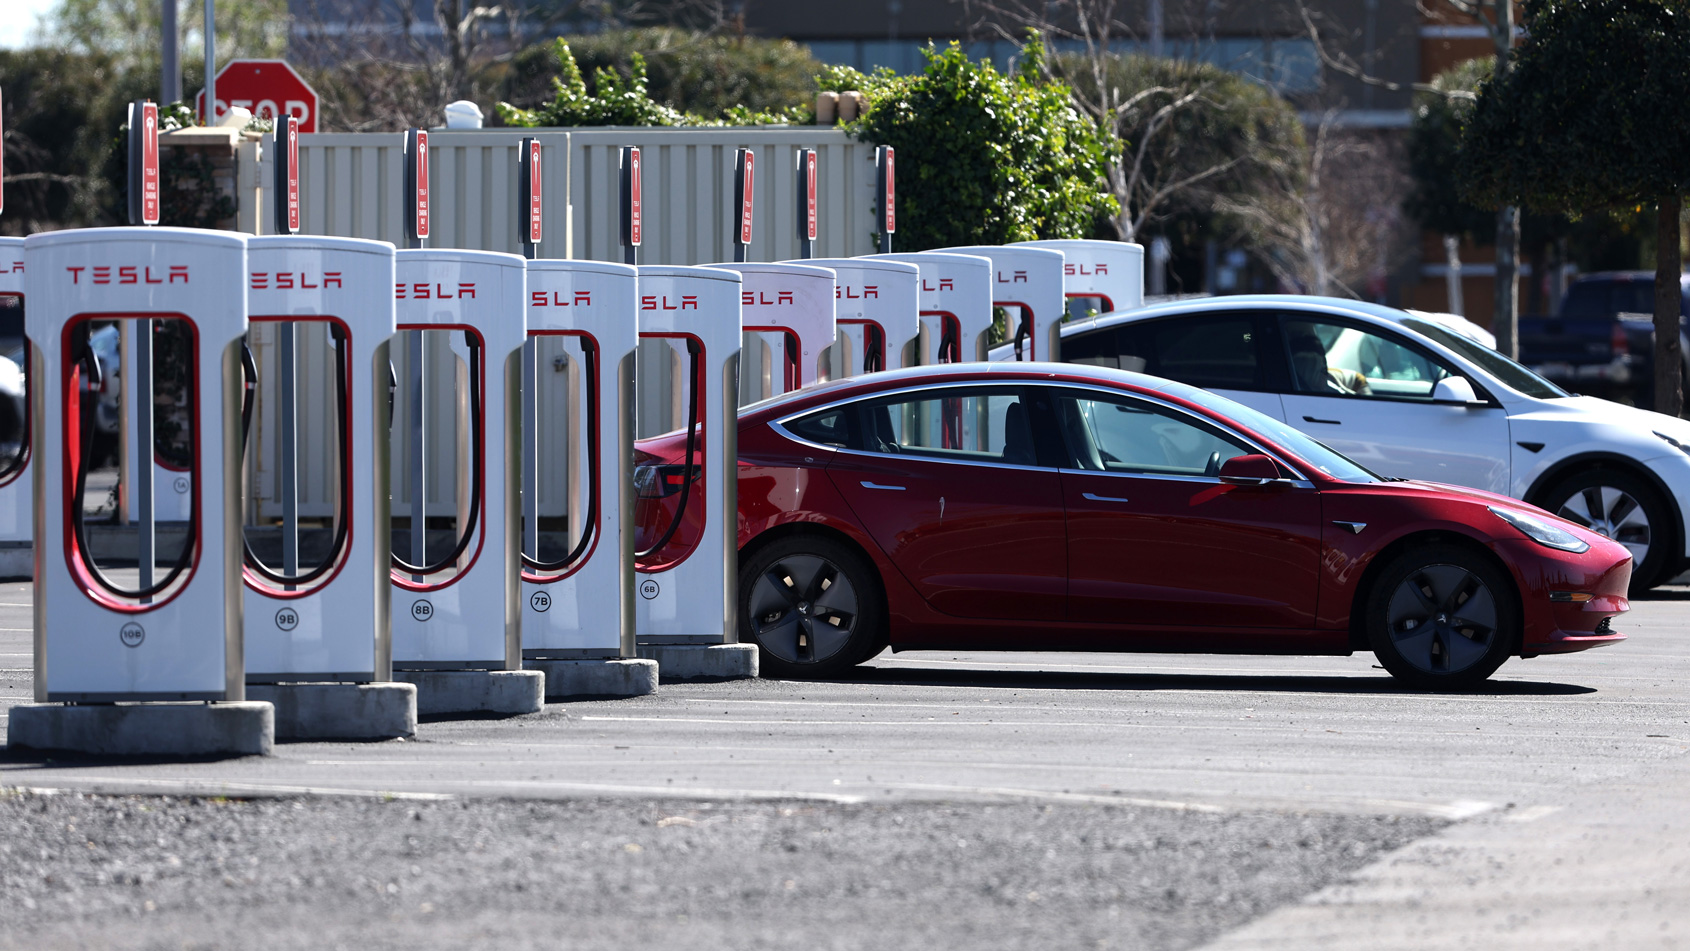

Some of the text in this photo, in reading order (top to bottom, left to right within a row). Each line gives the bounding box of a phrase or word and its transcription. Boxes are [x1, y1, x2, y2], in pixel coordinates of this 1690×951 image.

[66, 266, 189, 284] TESLA
[251, 272, 343, 289] ESLA
[395, 283, 477, 300] ESLA
[531, 291, 591, 307] SLA
[641, 295, 698, 311] SLA
[644, 585, 656, 593] 6B
[534, 596, 549, 606] 7B
[415, 605, 431, 615] 8B
[278, 614, 296, 625] 9B
[123, 630, 143, 640] 10B
